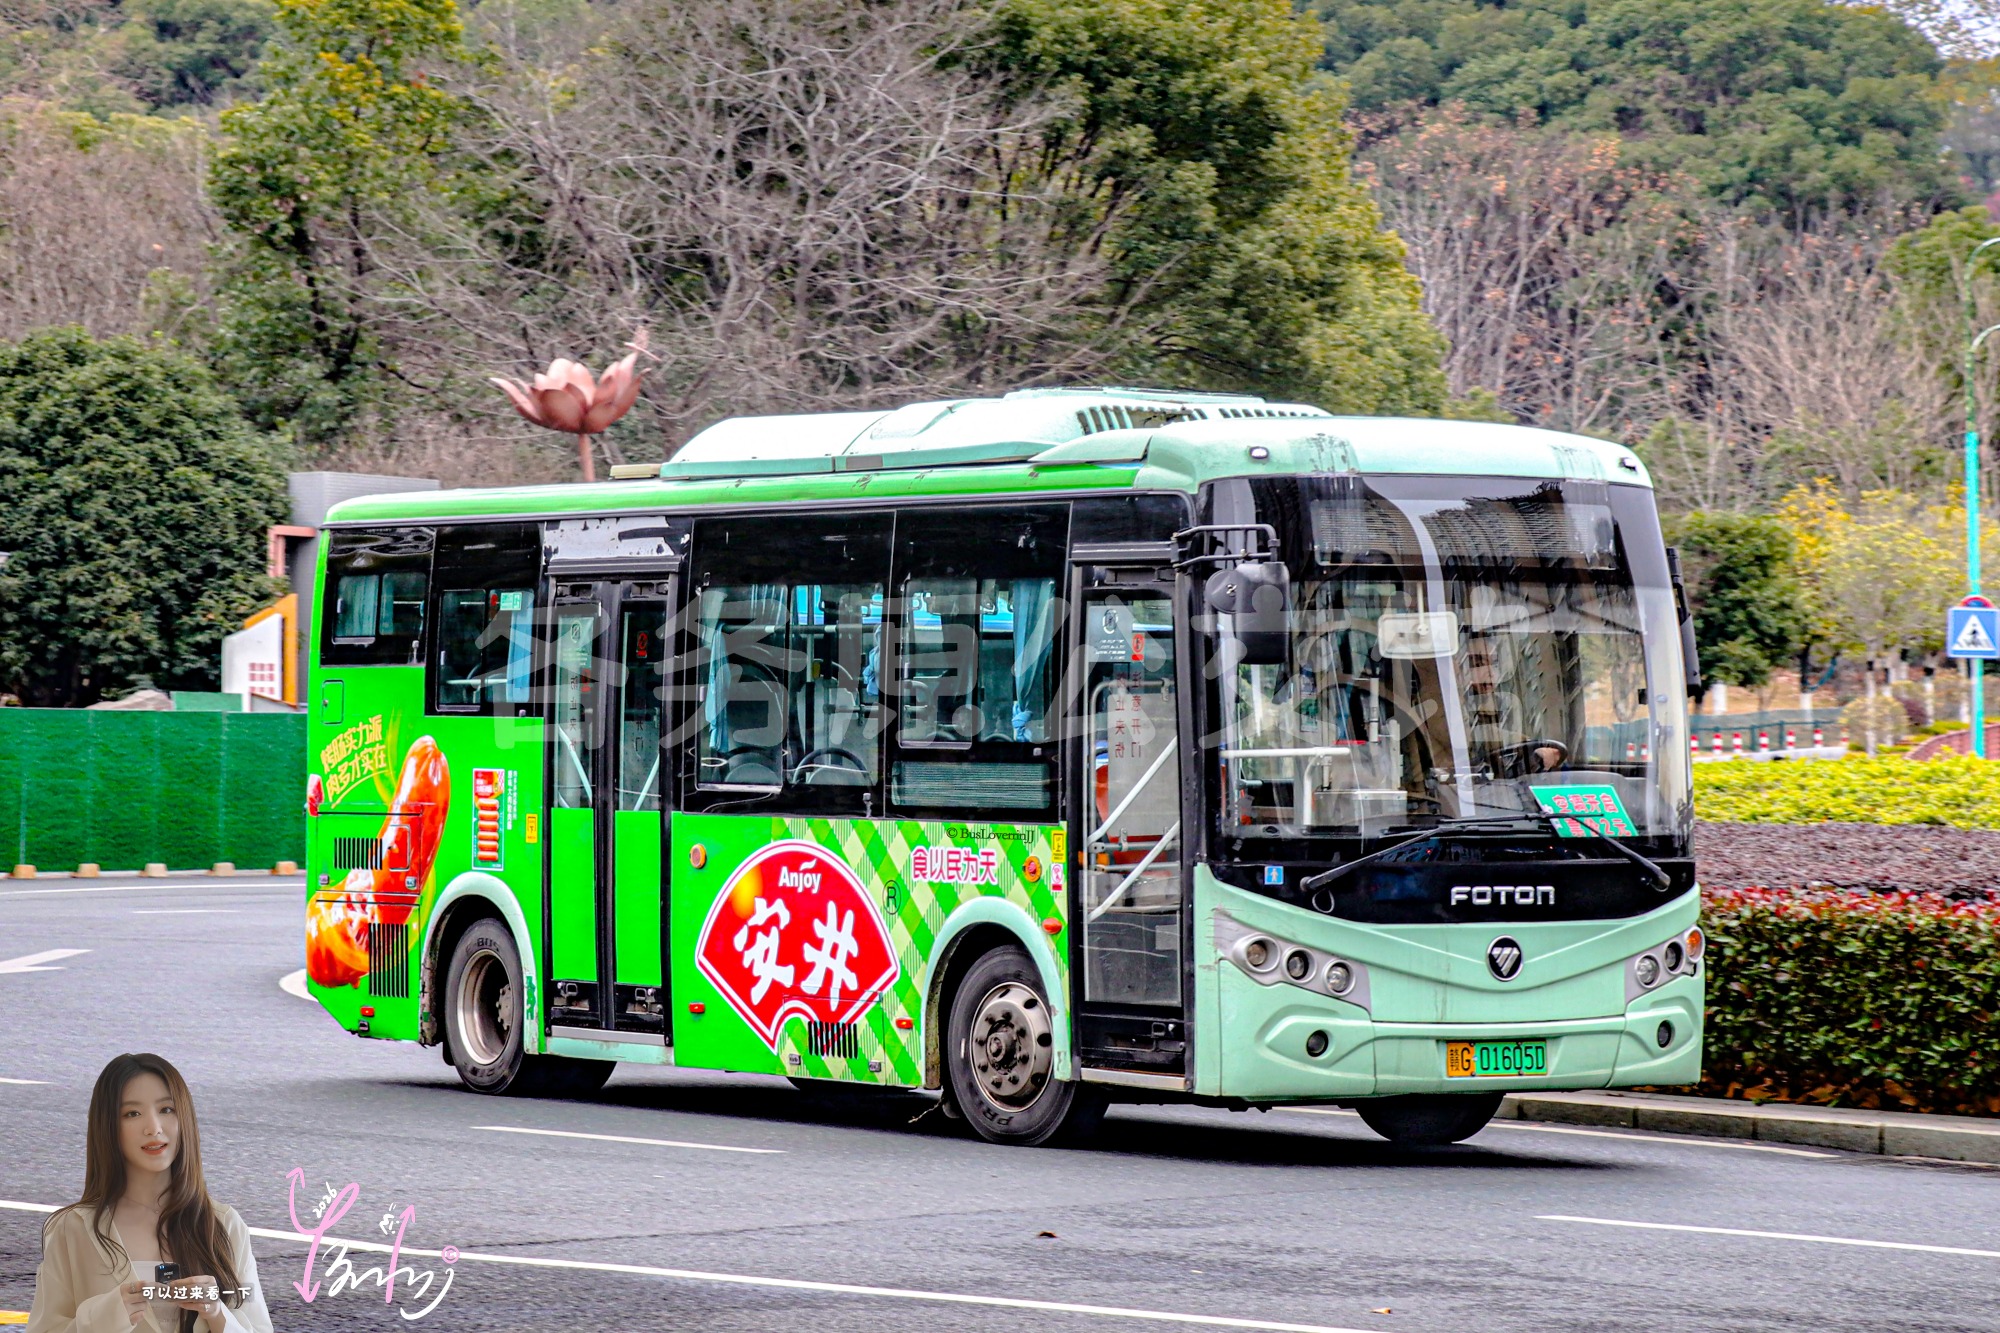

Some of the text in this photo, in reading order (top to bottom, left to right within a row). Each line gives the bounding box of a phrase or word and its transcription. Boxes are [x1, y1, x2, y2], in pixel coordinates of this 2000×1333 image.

[321, 714, 383, 775] 烤肠实力派
[326, 743, 387, 803] 肉多才实在
[1552, 793, 1619, 813] 空调开启
[778, 860, 821, 894] Anjoy
[912, 847, 997, 883] 食以民为天
[1450, 886, 1556, 906] FOTON
[733, 896, 859, 1012] 安井
